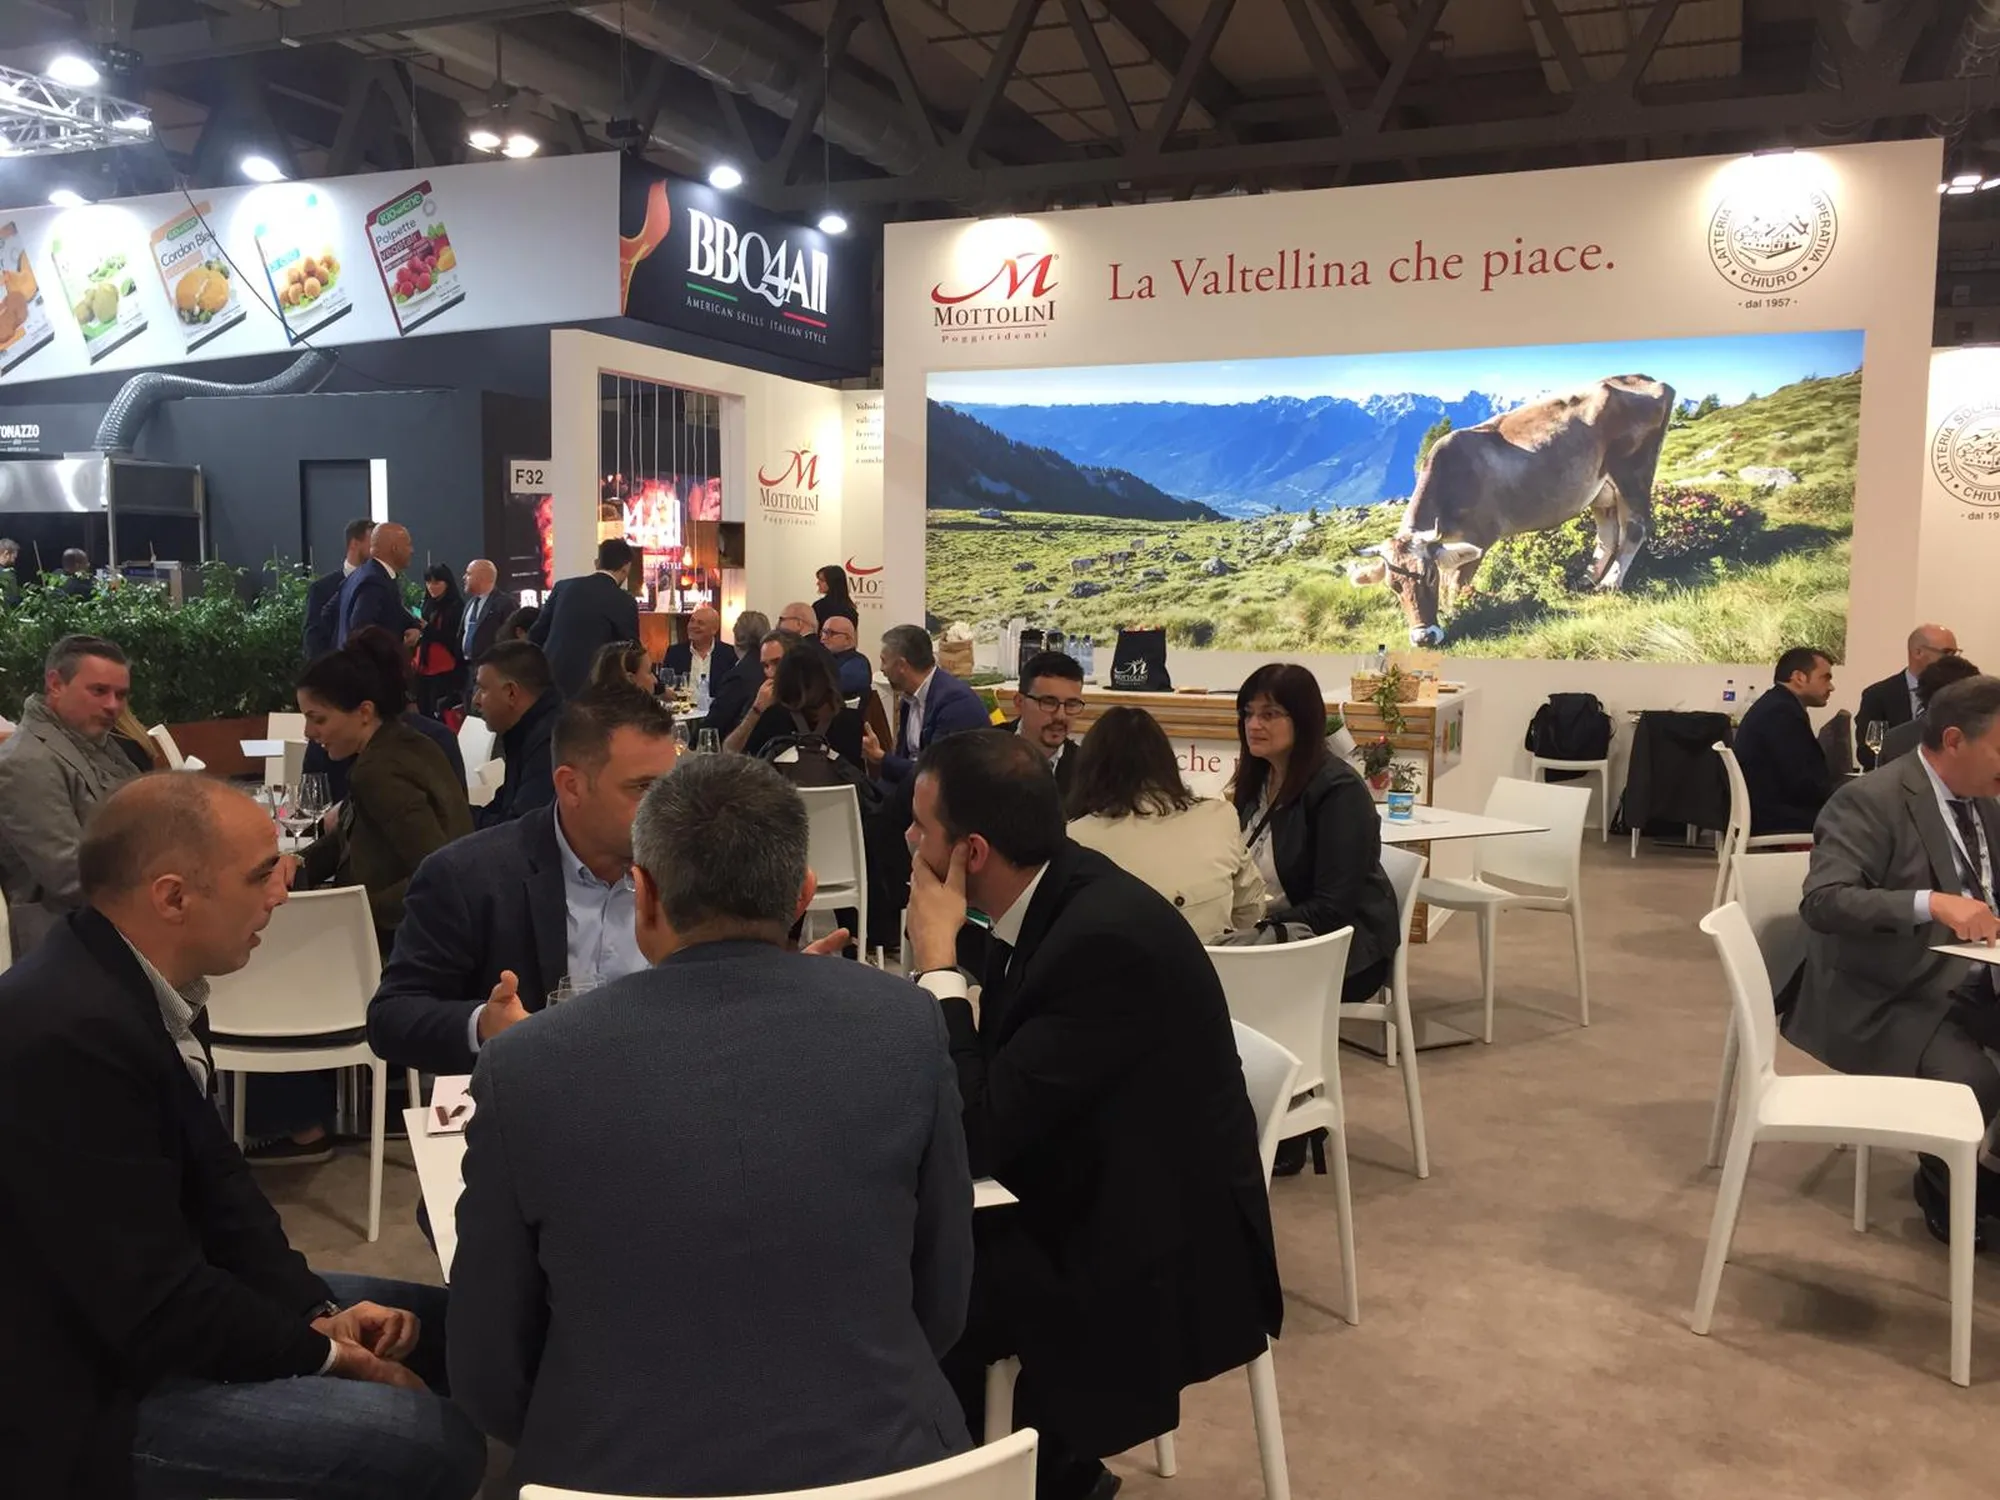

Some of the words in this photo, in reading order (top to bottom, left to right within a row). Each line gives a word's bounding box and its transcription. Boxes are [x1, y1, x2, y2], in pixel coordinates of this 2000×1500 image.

[376, 219, 416, 248] Polpette
[1713, 208, 1732, 269] LATTERIA
[1808, 190, 1831, 263] OPERATIVA
[161, 242, 196, 267] Cordon
[686, 207, 829, 315] BBQ4All
[1108, 262, 1156, 301] La
[1171, 248, 1371, 298] Valtellina
[1388, 239, 1464, 283] che
[1480, 237, 1616, 292] piace.
[1741, 269, 1798, 288] CHIURO
[934, 300, 1057, 327] MOTTOLINI
[1745, 299, 1762, 309] dal
[1766, 298, 1791, 308] 1957
[685, 295, 734, 319] AMERICAN
[736, 311, 764, 327] SKILLS
[769, 321, 802, 337] ITALIAN
[804, 329, 828, 345] STYLE
[941, 330, 1047, 344] Poggiridenti
[0, 424, 40, 438] ONAZZO
[1936, 426, 1955, 483] LATTERIA
[515, 468, 543, 485] F32
[760, 487, 819, 512] MOTTOLINI
[1967, 511, 1984, 521] dal
[1988, 511, 2000, 521] 19
[1177, 744, 1221, 774] che
